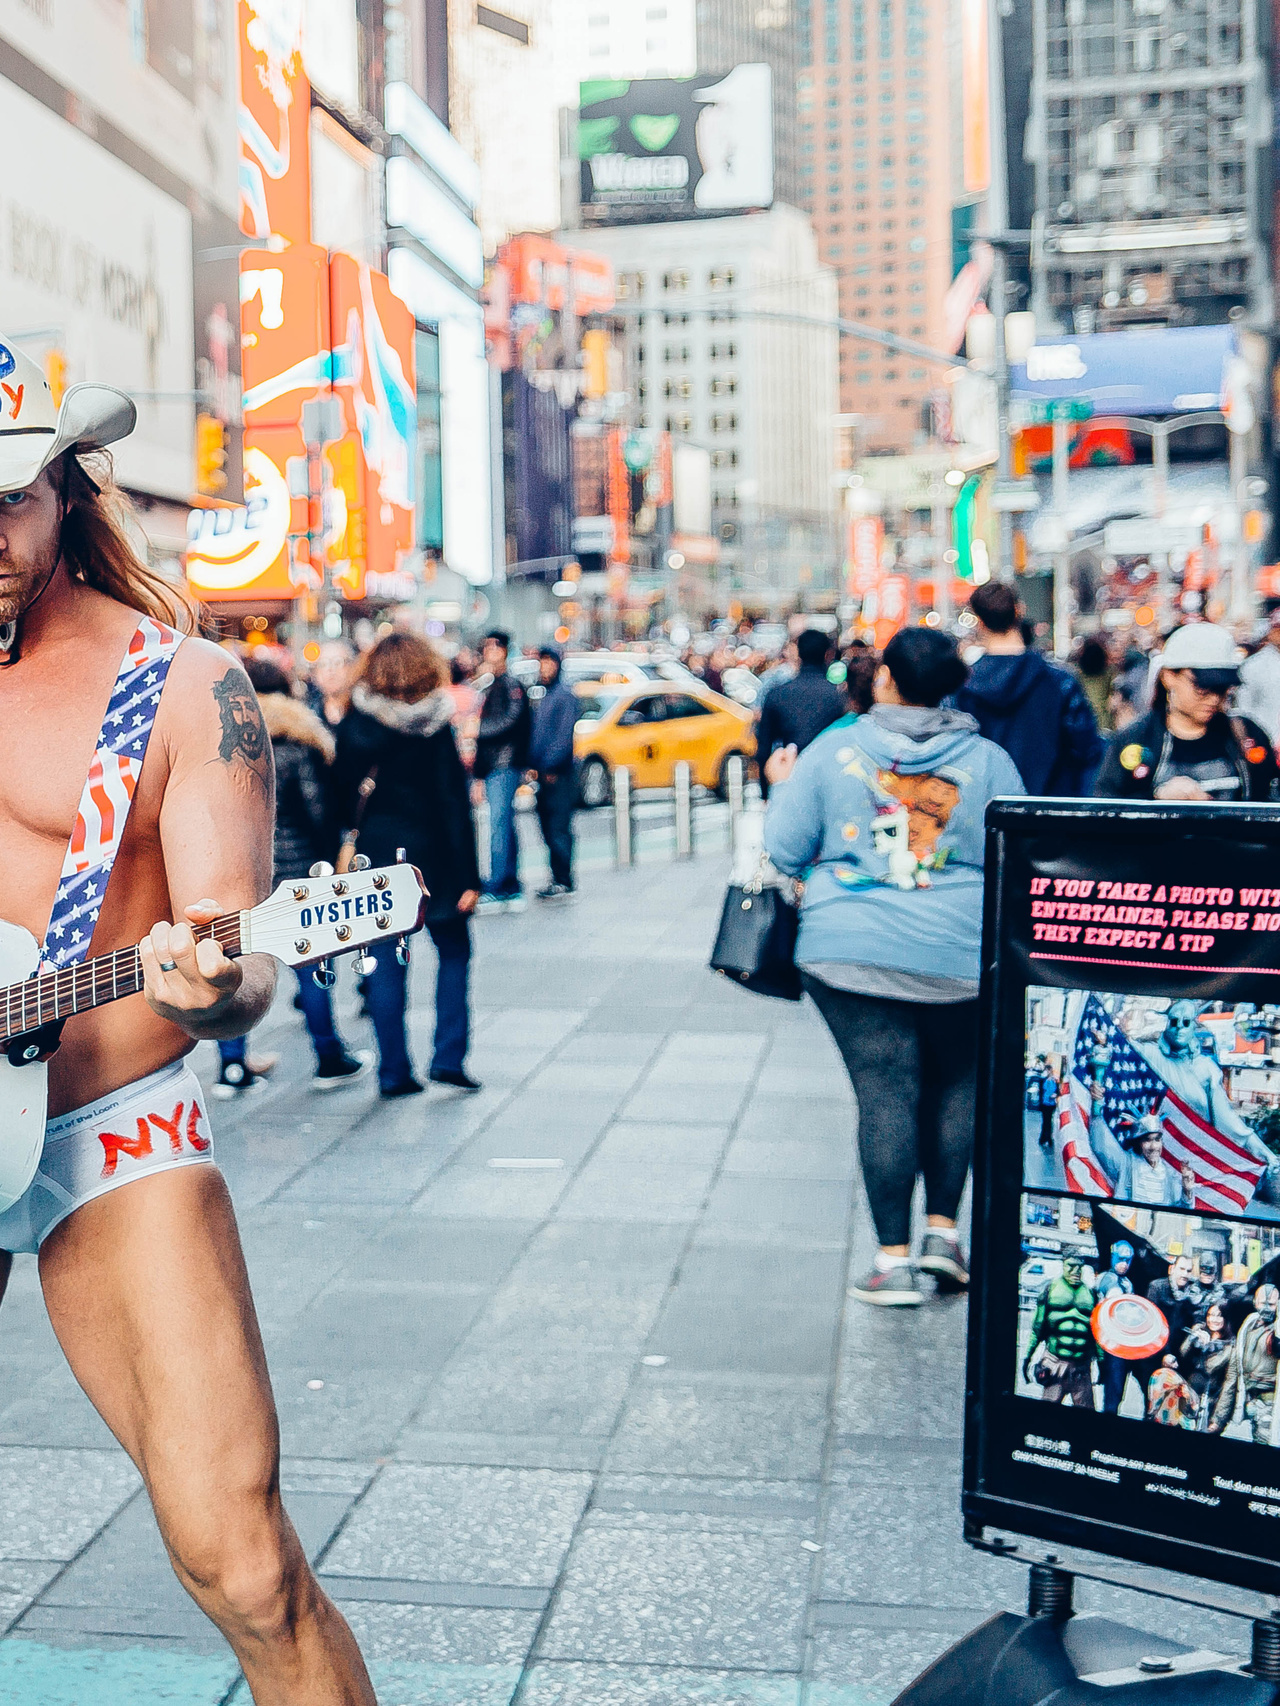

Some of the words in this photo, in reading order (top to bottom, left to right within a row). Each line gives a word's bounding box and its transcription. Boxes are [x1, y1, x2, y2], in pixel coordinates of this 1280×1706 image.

[1029, 878, 1051, 895] IF
[1053, 879, 1095, 898] YOU
[1097, 881, 1152, 902] TAKE
[1152, 885, 1167, 903] A
[1168, 886, 1234, 906] PHOTO
[300, 890, 393, 929] OYSTERS
[1031, 900, 1168, 929] ENTERTAINER,
[1170, 909, 1249, 930] PLEASE
[1251, 913, 1280, 931] NO
[1033, 923, 1082, 943] THEY
[1083, 927, 1162, 949] EXPECT
[1161, 933, 1176, 950] A
[1179, 934, 1215, 953] TIP
[46, 1123, 64, 1134] ruit
[65, 1119, 75, 1128] of
[76, 1113, 93, 1124] the
[93, 1101, 120, 1117] Loom
[98, 1098, 210, 1180] NYC
[1233, 1480, 1252, 1494] don
